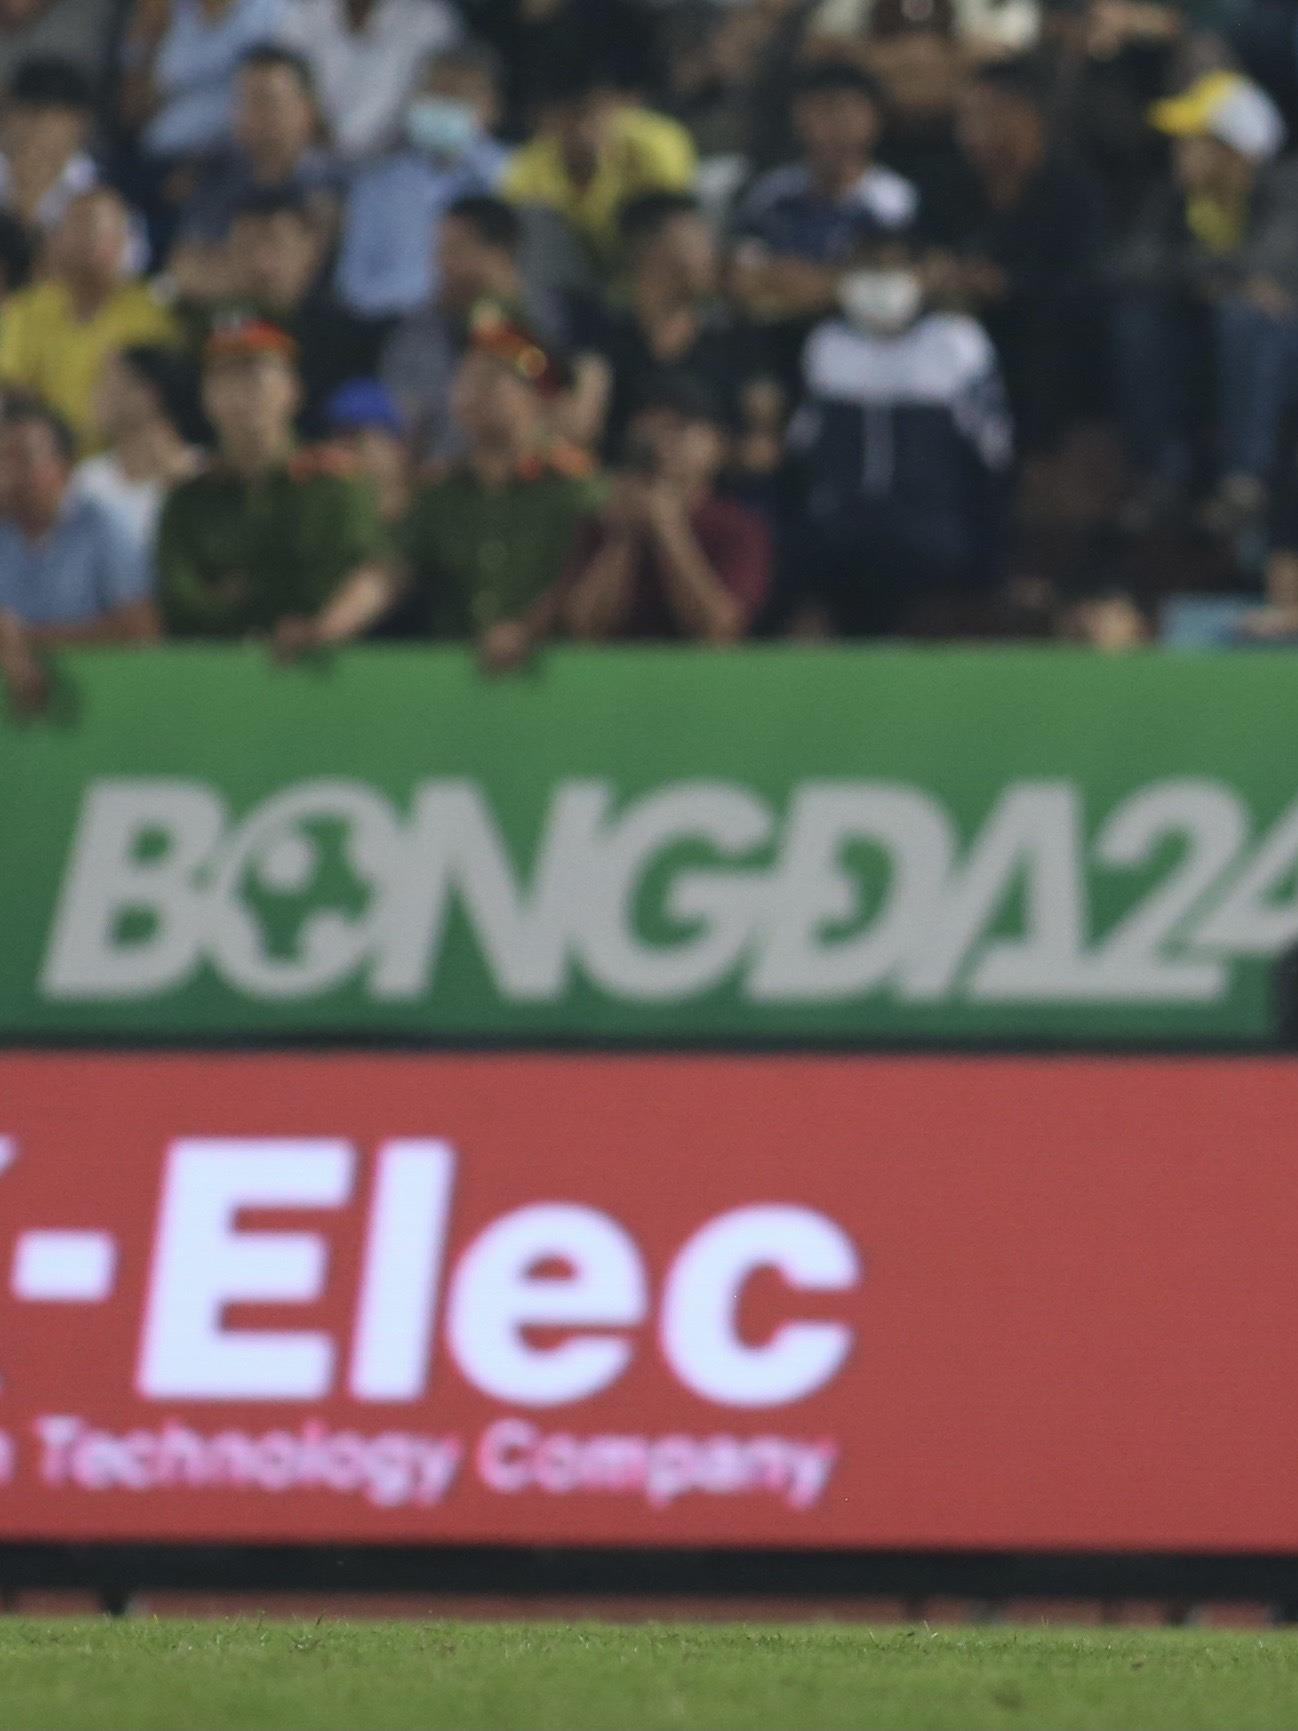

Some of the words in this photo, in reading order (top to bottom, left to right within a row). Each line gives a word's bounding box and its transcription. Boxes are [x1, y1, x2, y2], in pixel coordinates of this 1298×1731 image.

[0, 1136, 860, 1406] -Elec
[35, 1414, 461, 1508] Technology
[477, 1418, 837, 1510] Company
